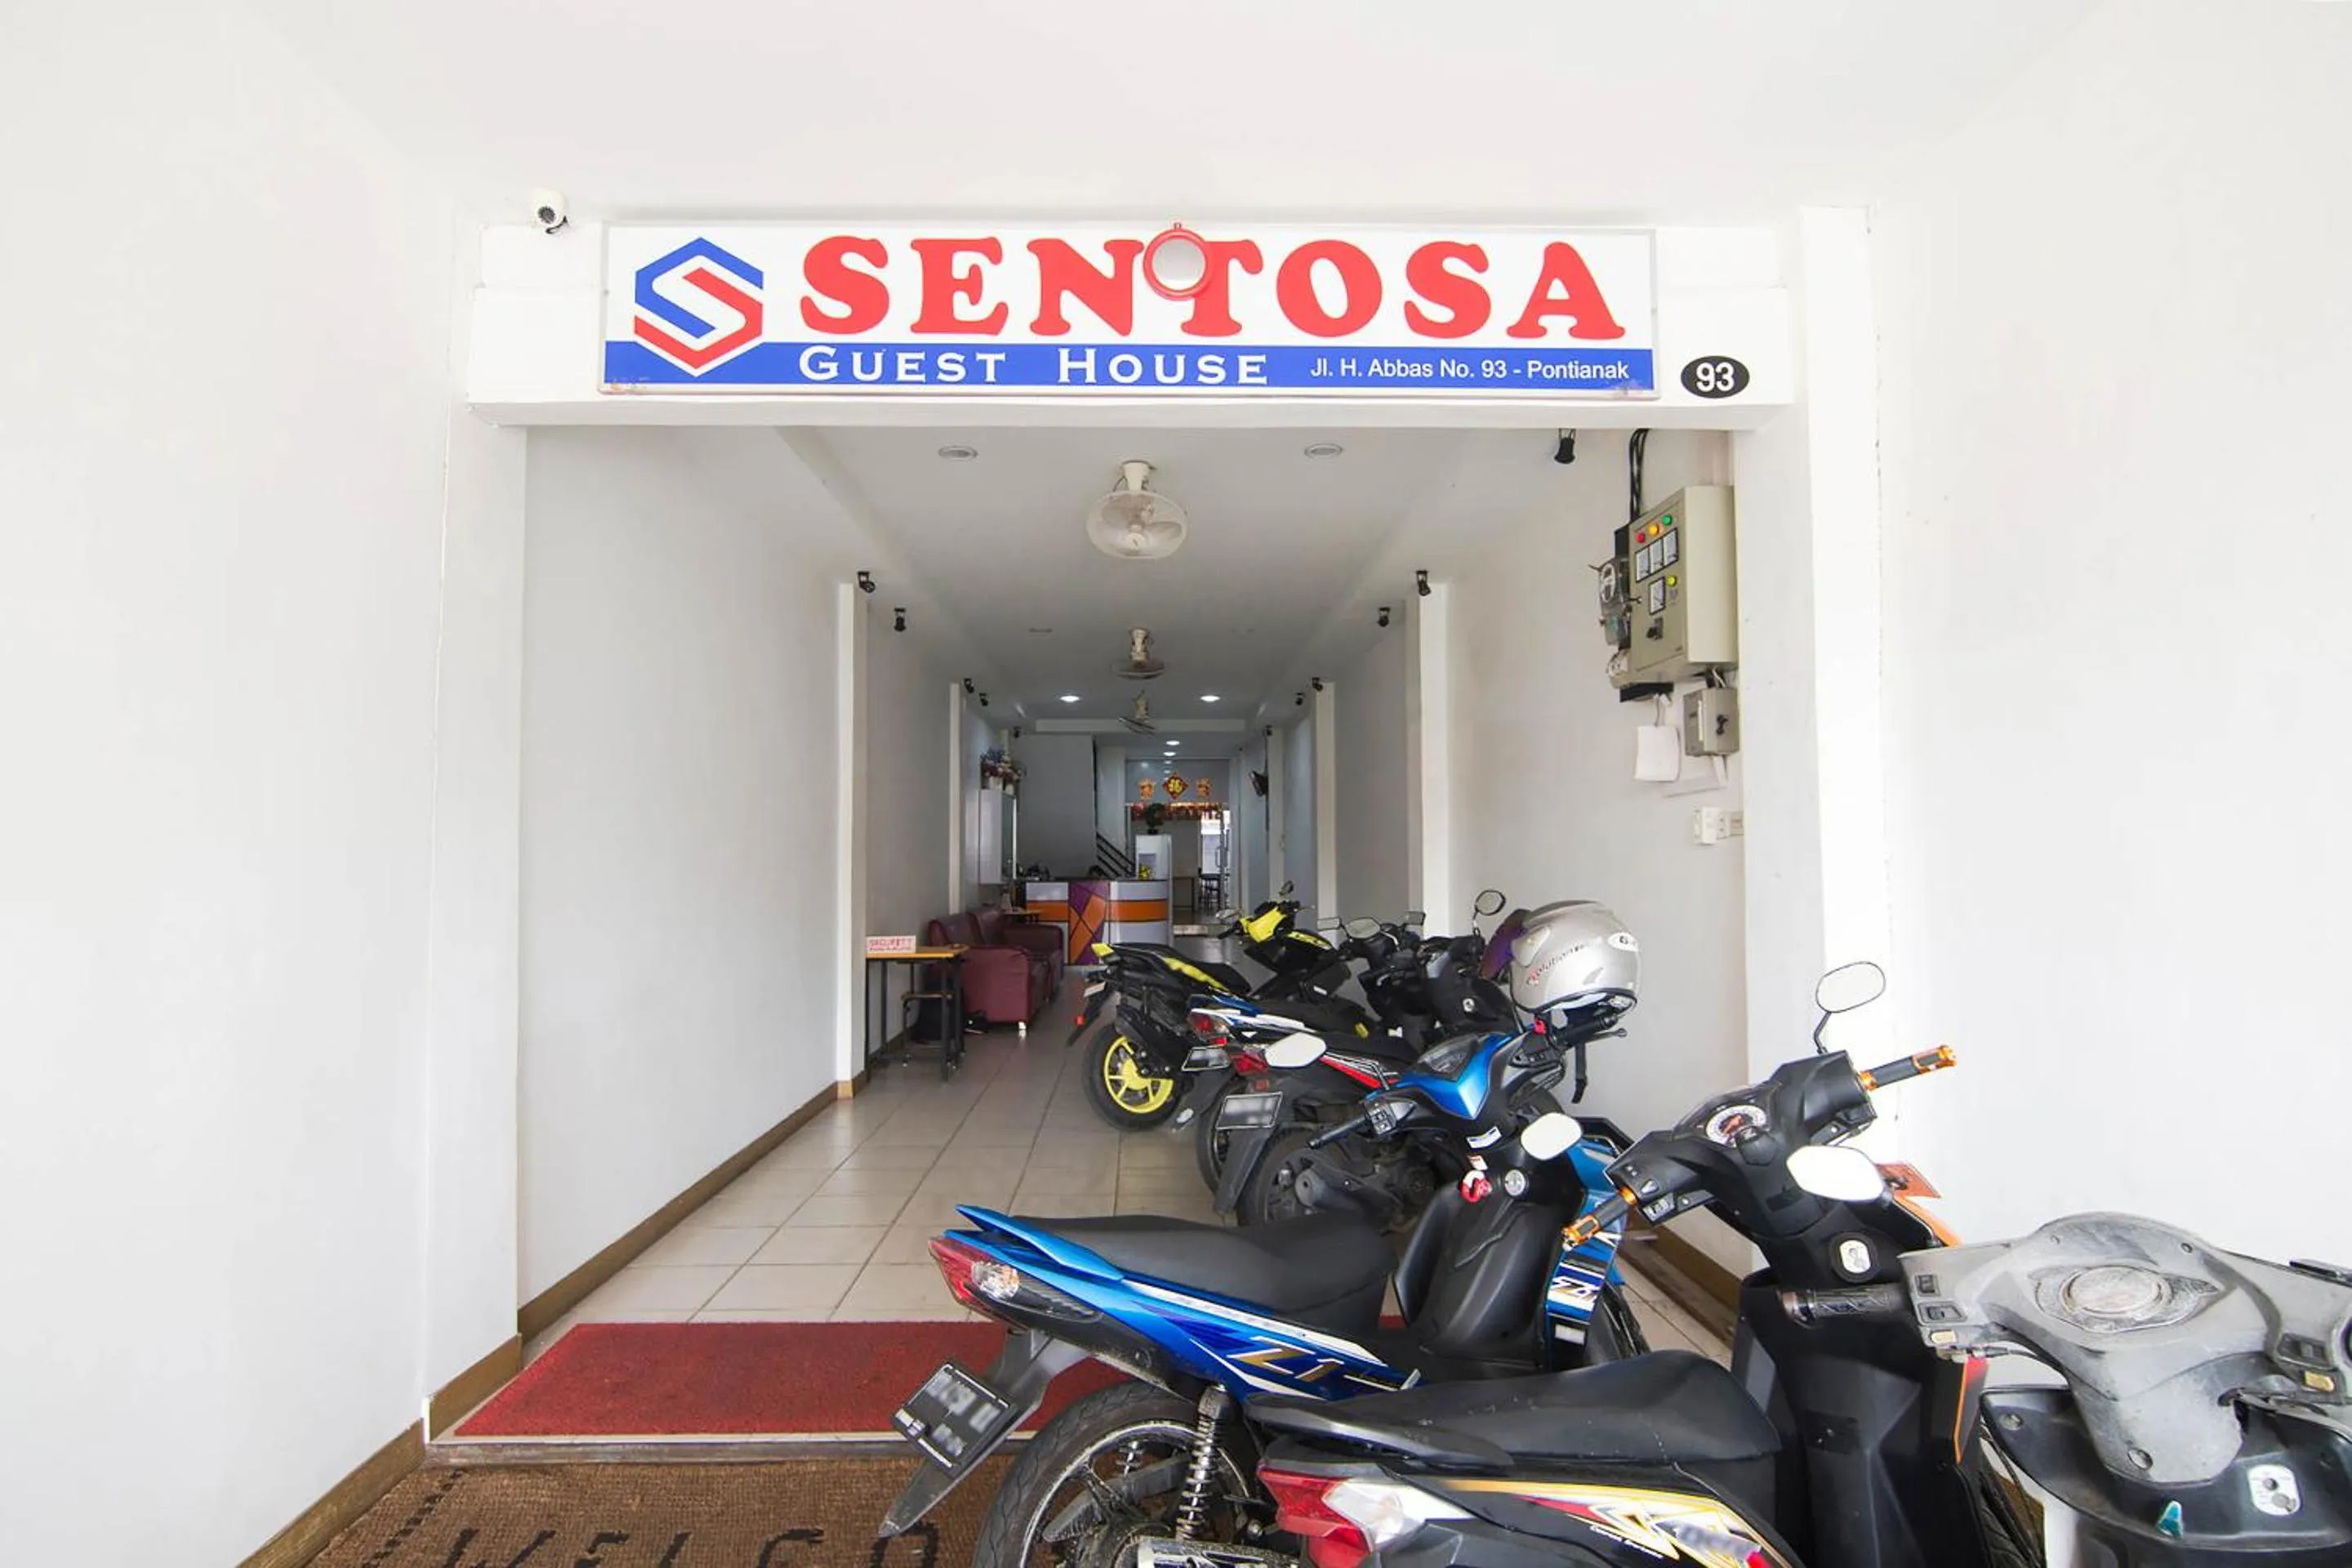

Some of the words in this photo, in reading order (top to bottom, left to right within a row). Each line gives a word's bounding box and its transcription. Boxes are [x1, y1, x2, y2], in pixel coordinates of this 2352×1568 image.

[800, 235, 1625, 340] SENTOSA
[799, 345, 1006, 383] GUEST
[1058, 348, 1268, 385] HOUSE
[1340, 359, 1361, 376] H.
[1368, 359, 1434, 377] Abbas
[1440, 359, 1474, 377] No.
[1481, 359, 1508, 377] 93
[1527, 360, 1629, 378] Pontianak
[1696, 362, 1735, 392] 93
